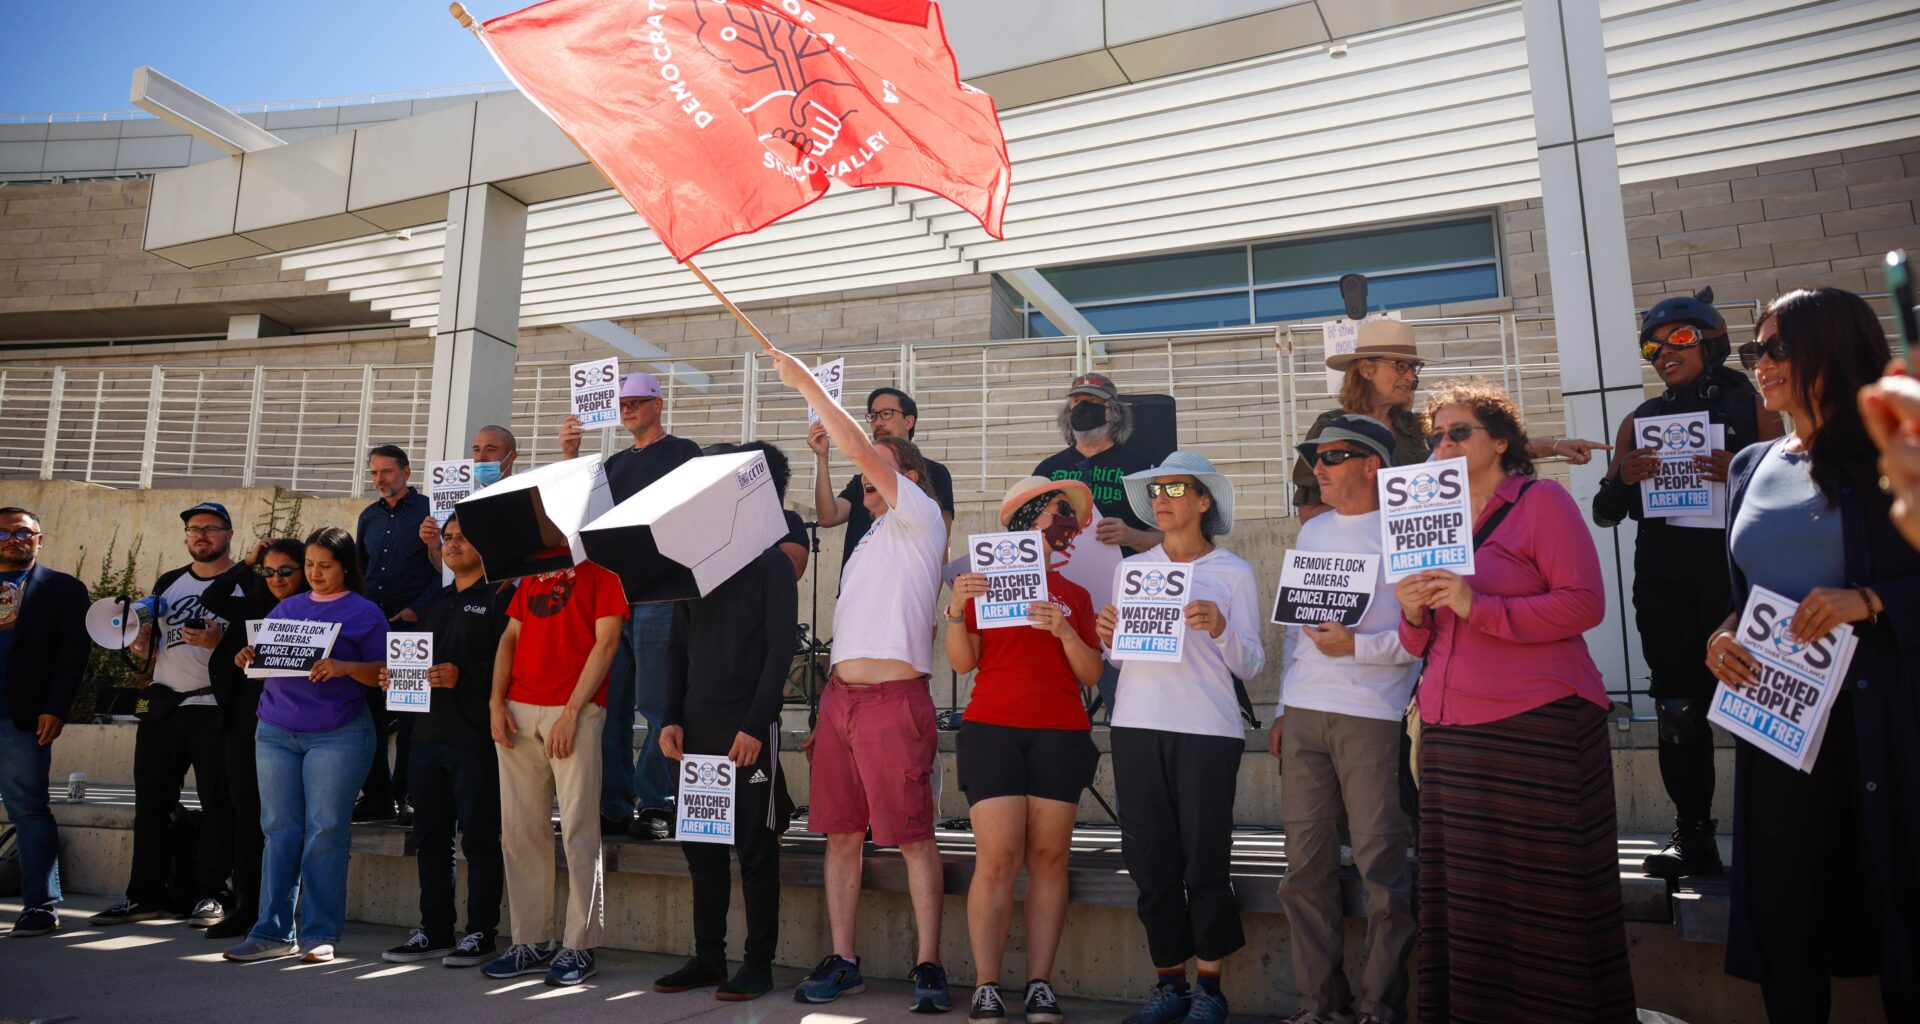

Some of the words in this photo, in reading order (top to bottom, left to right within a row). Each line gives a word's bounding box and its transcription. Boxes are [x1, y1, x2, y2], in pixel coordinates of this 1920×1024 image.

[762, 151, 818, 183] SILICO
[823, 130, 890, 177] VALLEY
[575, 390, 614, 404] WATCHED
[578, 398, 612, 413] PEOPLE
[600, 410, 616, 421] FREE
[1654, 476, 1703, 490] PEOPLE
[432, 490, 470, 502] WATCHED
[1652, 493, 1687, 506] AREN'T
[1688, 492, 1708, 505] FREE
[1388, 512, 1463, 535] WATCHED
[1396, 529, 1457, 550] PEOPLE
[1293, 556, 1332, 570] REMOVE
[1334, 558, 1366, 572] FLOCK
[1392, 550, 1432, 570] AREN'T
[1434, 546, 1465, 565] FREE
[1304, 573, 1350, 587] CAMERAS
[986, 587, 1037, 602] PEOPLE
[1287, 590, 1324, 605] CANCEL
[1326, 592, 1359, 607] FLOCK
[984, 604, 1018, 618] AREN'T
[1122, 607, 1180, 621] WATCHED
[1295, 606, 1347, 622] CONTRACT
[268, 623, 301, 634] REMOVE
[301, 625, 326, 635] FLOCK
[1124, 620, 1173, 634] PEOPLE
[274, 634, 312, 644] CAMERAS
[1118, 636, 1151, 650] AREN'T
[1152, 638, 1176, 651] FREE
[260, 645, 289, 656] CANCEL
[290, 647, 316, 657] FLOCK
[264, 657, 306, 667] CONTRACT
[391, 669, 426, 679] WATCHED
[394, 680, 423, 691] PEOPLE
[1721, 694, 1770, 730] AREN'T
[1768, 719, 1802, 749] FREE
[684, 794, 730, 808] WATCHED
[687, 806, 726, 820] PEOPLE
[682, 820, 711, 834] AREN'T
[712, 822, 730, 835] FREE
